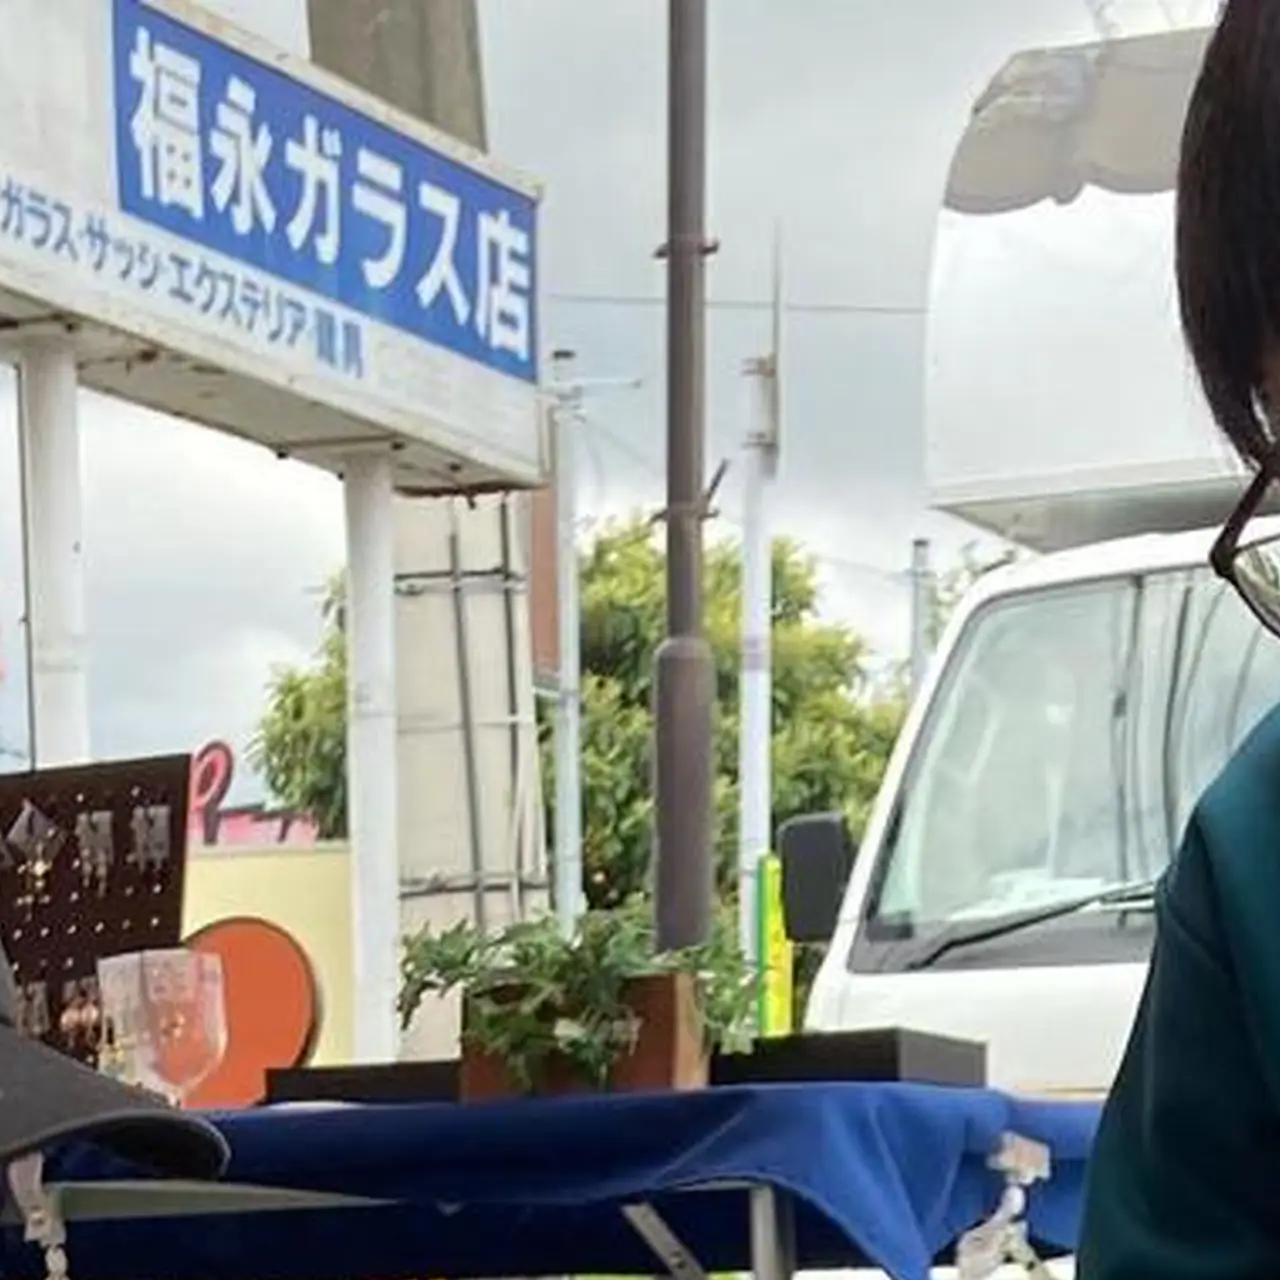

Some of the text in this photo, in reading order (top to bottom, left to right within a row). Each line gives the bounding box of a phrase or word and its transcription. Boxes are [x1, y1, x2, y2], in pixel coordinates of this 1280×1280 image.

[128, 24, 532, 363] 福永ガラス店
